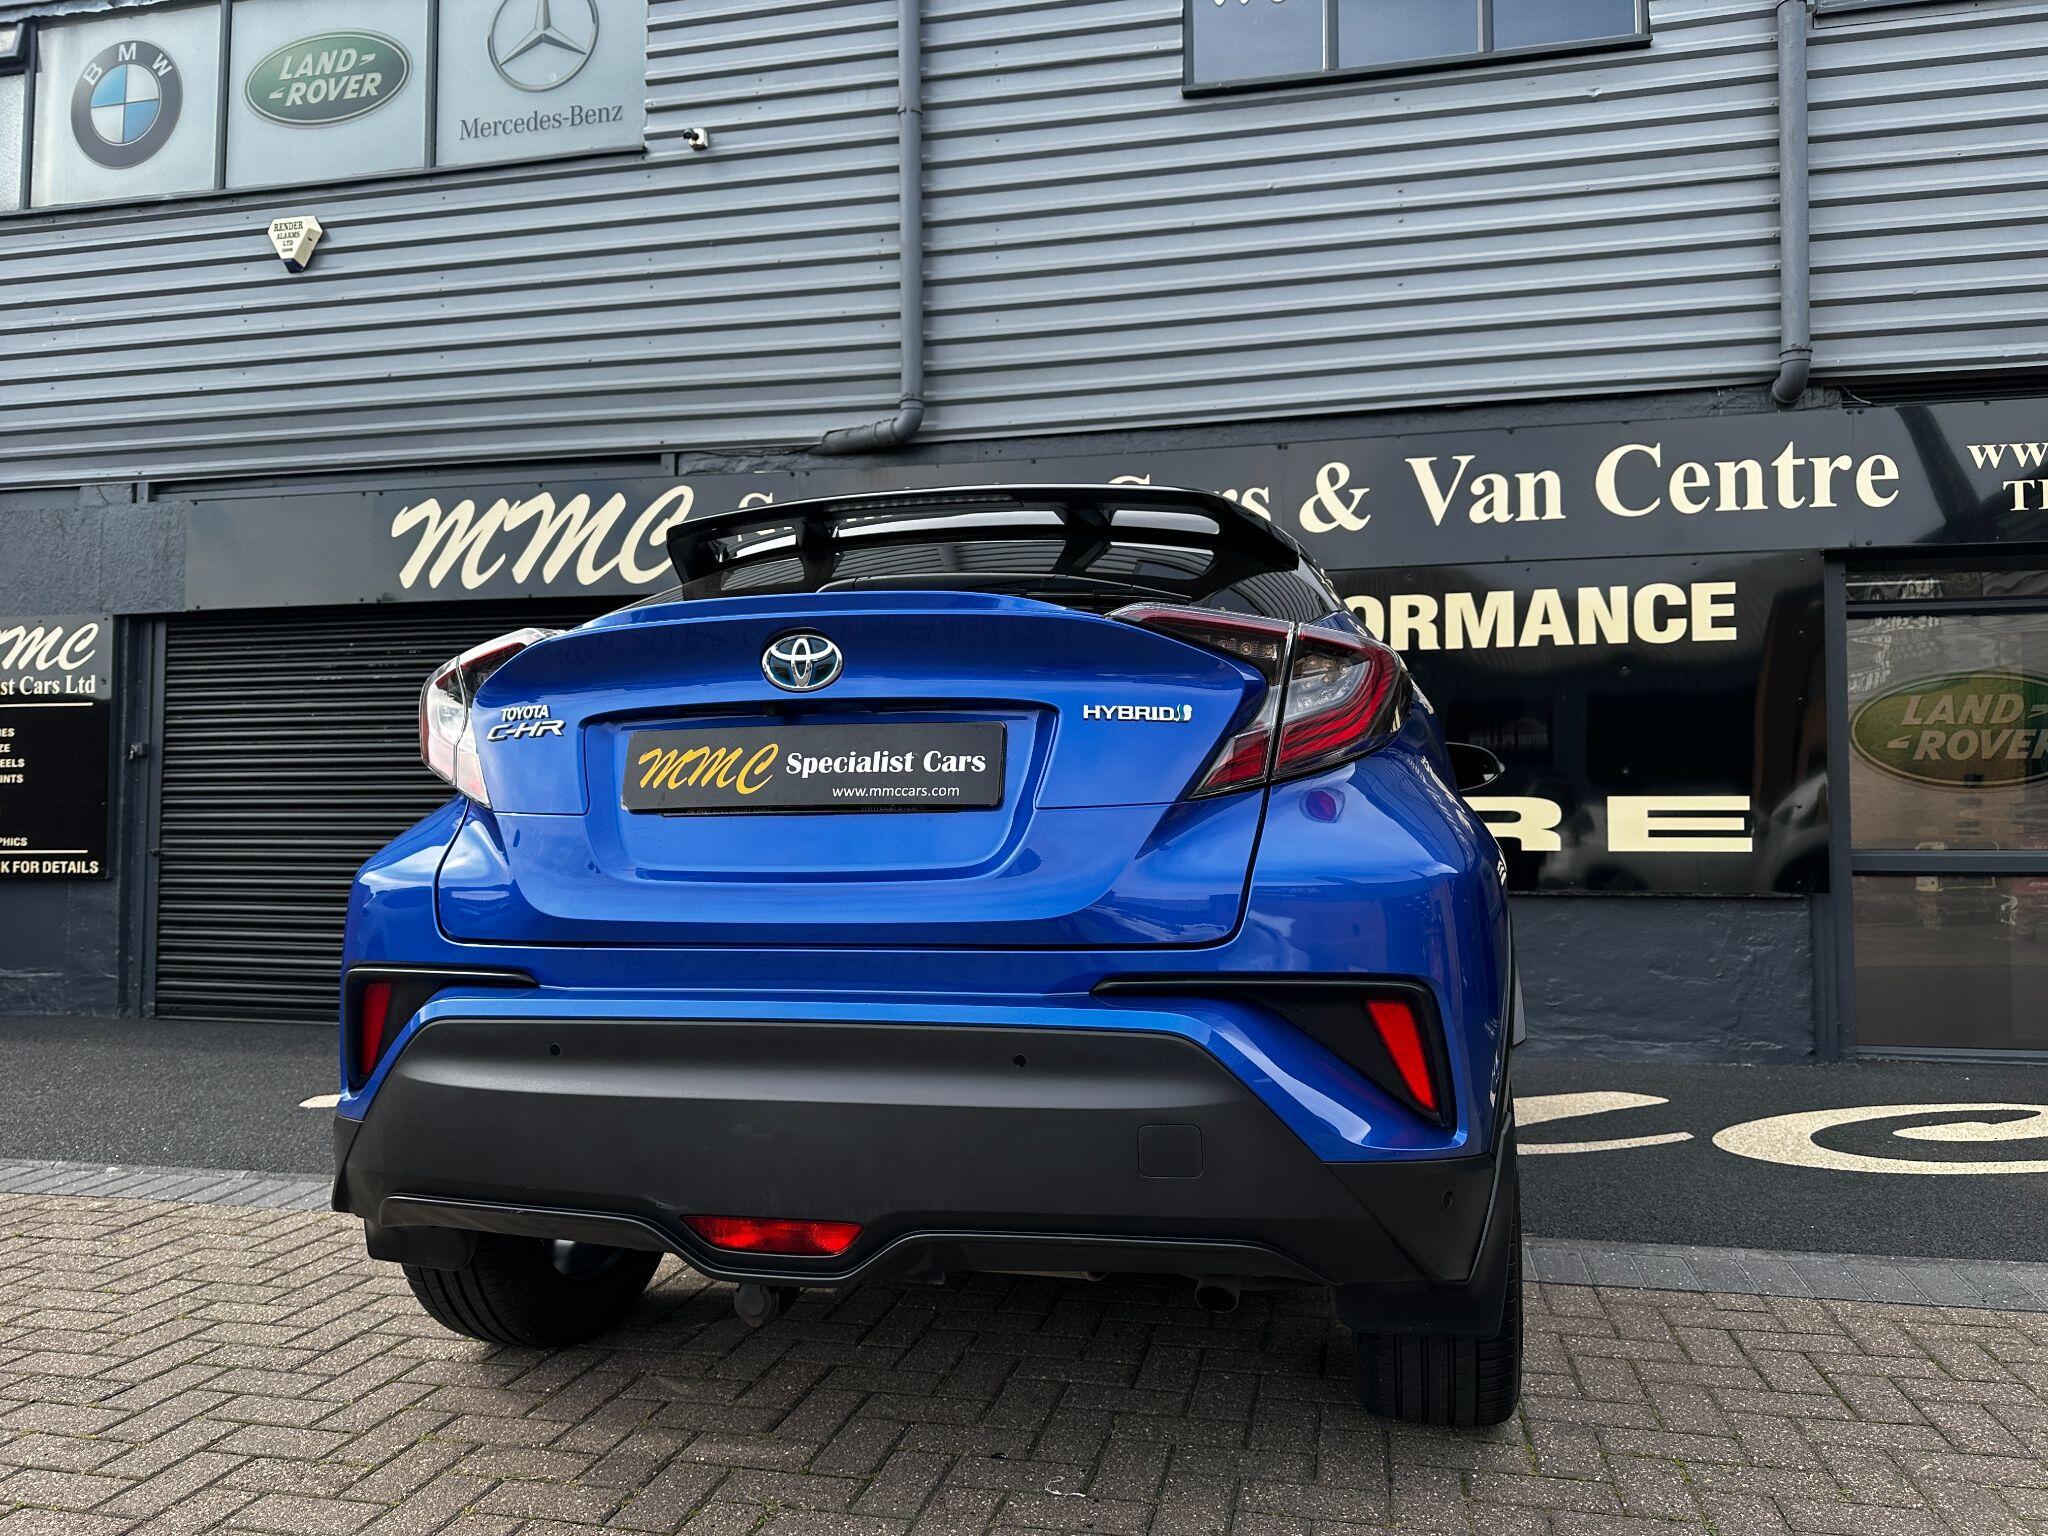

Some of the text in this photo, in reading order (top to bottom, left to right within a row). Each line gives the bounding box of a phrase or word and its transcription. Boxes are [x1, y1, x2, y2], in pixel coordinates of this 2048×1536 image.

[83, 43, 172, 86] BMW
[279, 47, 358, 81] LAND
[284, 72, 382, 107] ROVER
[458, 105, 624, 141] Mercedes-Benz
[274, 221, 303, 231] RENDER
[277, 231, 300, 239] ALARMS
[391, 485, 695, 590] MMC
[1299, 461, 1371, 534] &
[1404, 454, 1566, 526] Van
[1595, 440, 1900, 518] Centre
[0, 622, 99, 671] MC
[19, 675, 61, 696] Cars
[65, 674, 97, 694] Ltd
[501, 704, 551, 722] TOYOTA
[1083, 704, 1177, 722] HYBRID
[1901, 693, 2025, 725] LAND
[487, 719, 567, 742] C-HR
[637, 742, 986, 795] MMC Specialist Cars
[832, 784, 960, 798] www.mmccars.com
[13, 861, 39, 873] FOR
[42, 860, 99, 873] DETAILS
